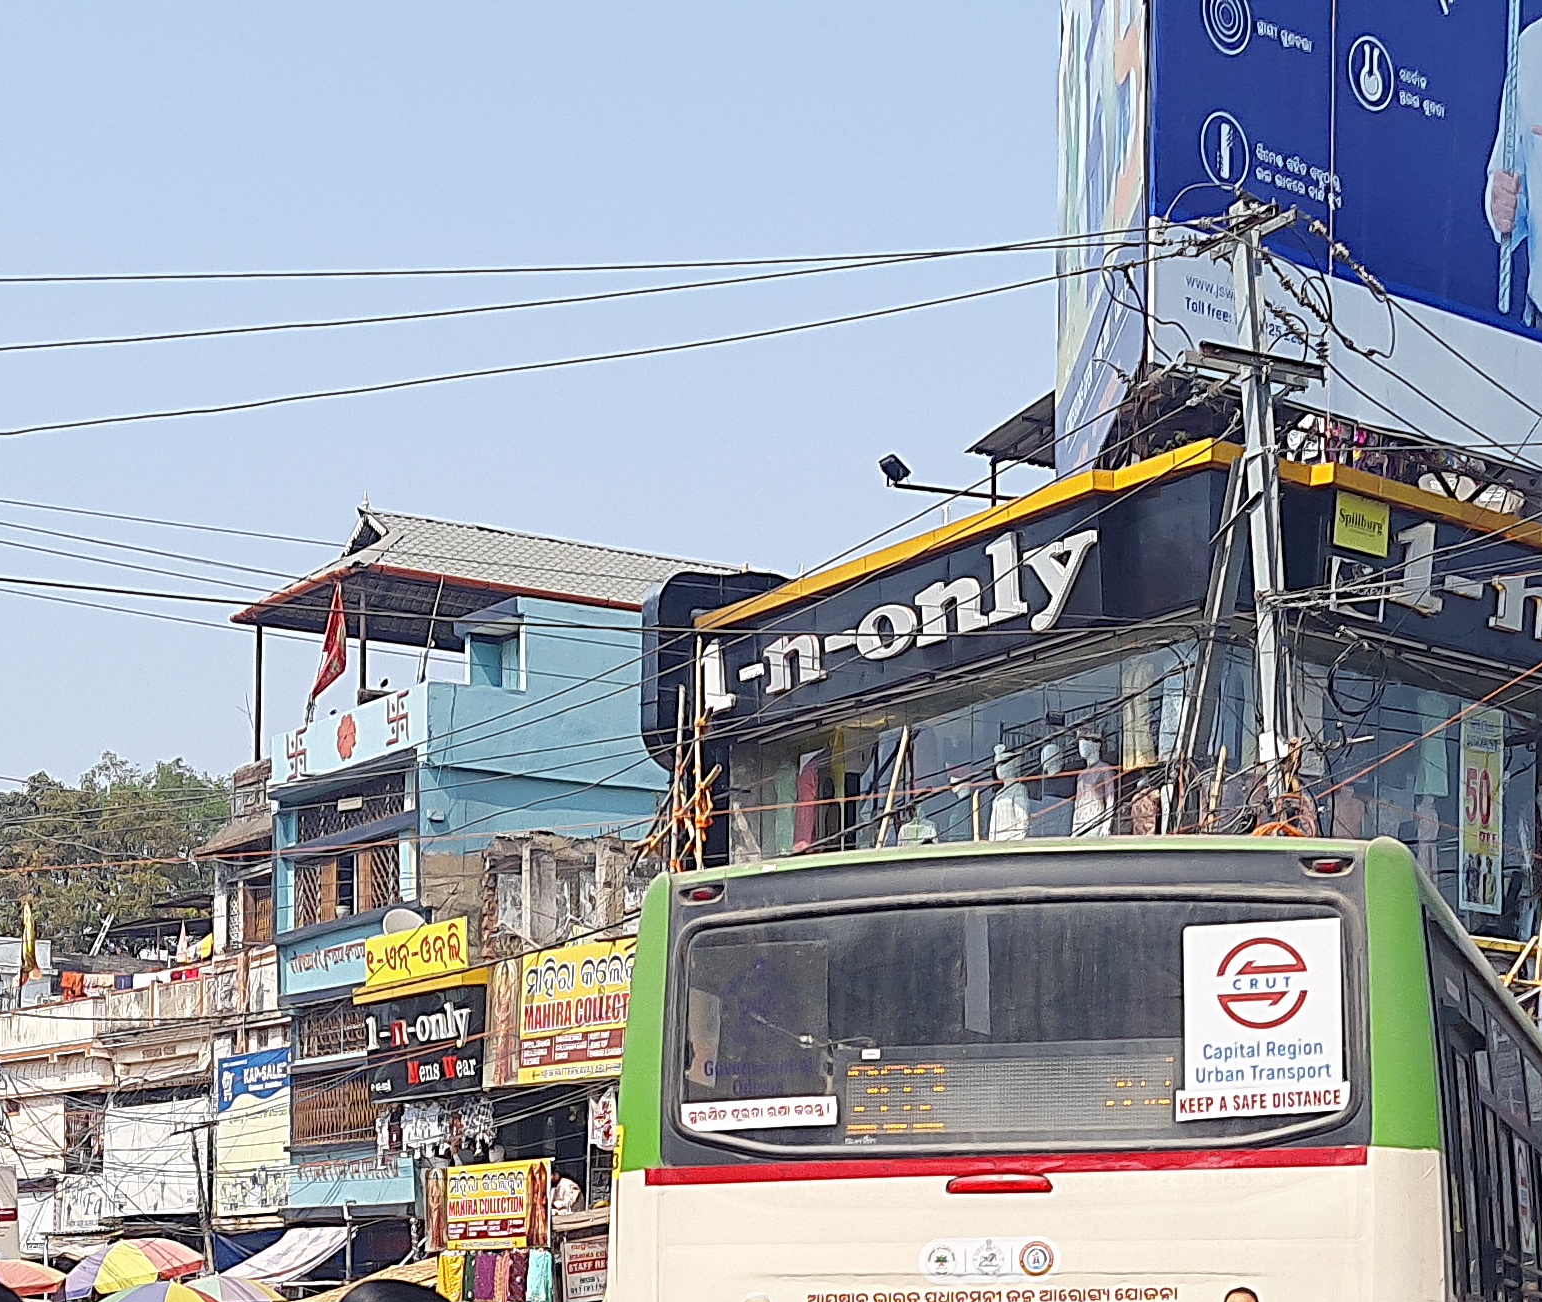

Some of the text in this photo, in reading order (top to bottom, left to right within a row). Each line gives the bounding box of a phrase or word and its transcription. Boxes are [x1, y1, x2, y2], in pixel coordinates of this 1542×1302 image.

[1185, 274, 1236, 301] www.jsw
[1185, 297, 1205, 315] Toll
[1465, 767, 1492, 827] 50
[1233, 976, 1291, 990] CRUT
[524, 993, 630, 1031] MAHIRA COLLECT
[1203, 1038, 1324, 1063] Capital Region
[407, 1061, 440, 1085] Mens
[442, 1055, 476, 1078] Wear
[1195, 1062, 1332, 1084] Urban Transport
[1180, 1089, 1341, 1114] KEEP A SAFE DISTANCE
[448, 1196, 524, 1217] MAHIRA COLLECTION
[568, 1259, 607, 1274] STAFF RE
[1039, 1288, 1110, 1302] ଆରୋଗ୍ୟ
[1115, 1286, 1178, 1302] ଯୋଜନା
